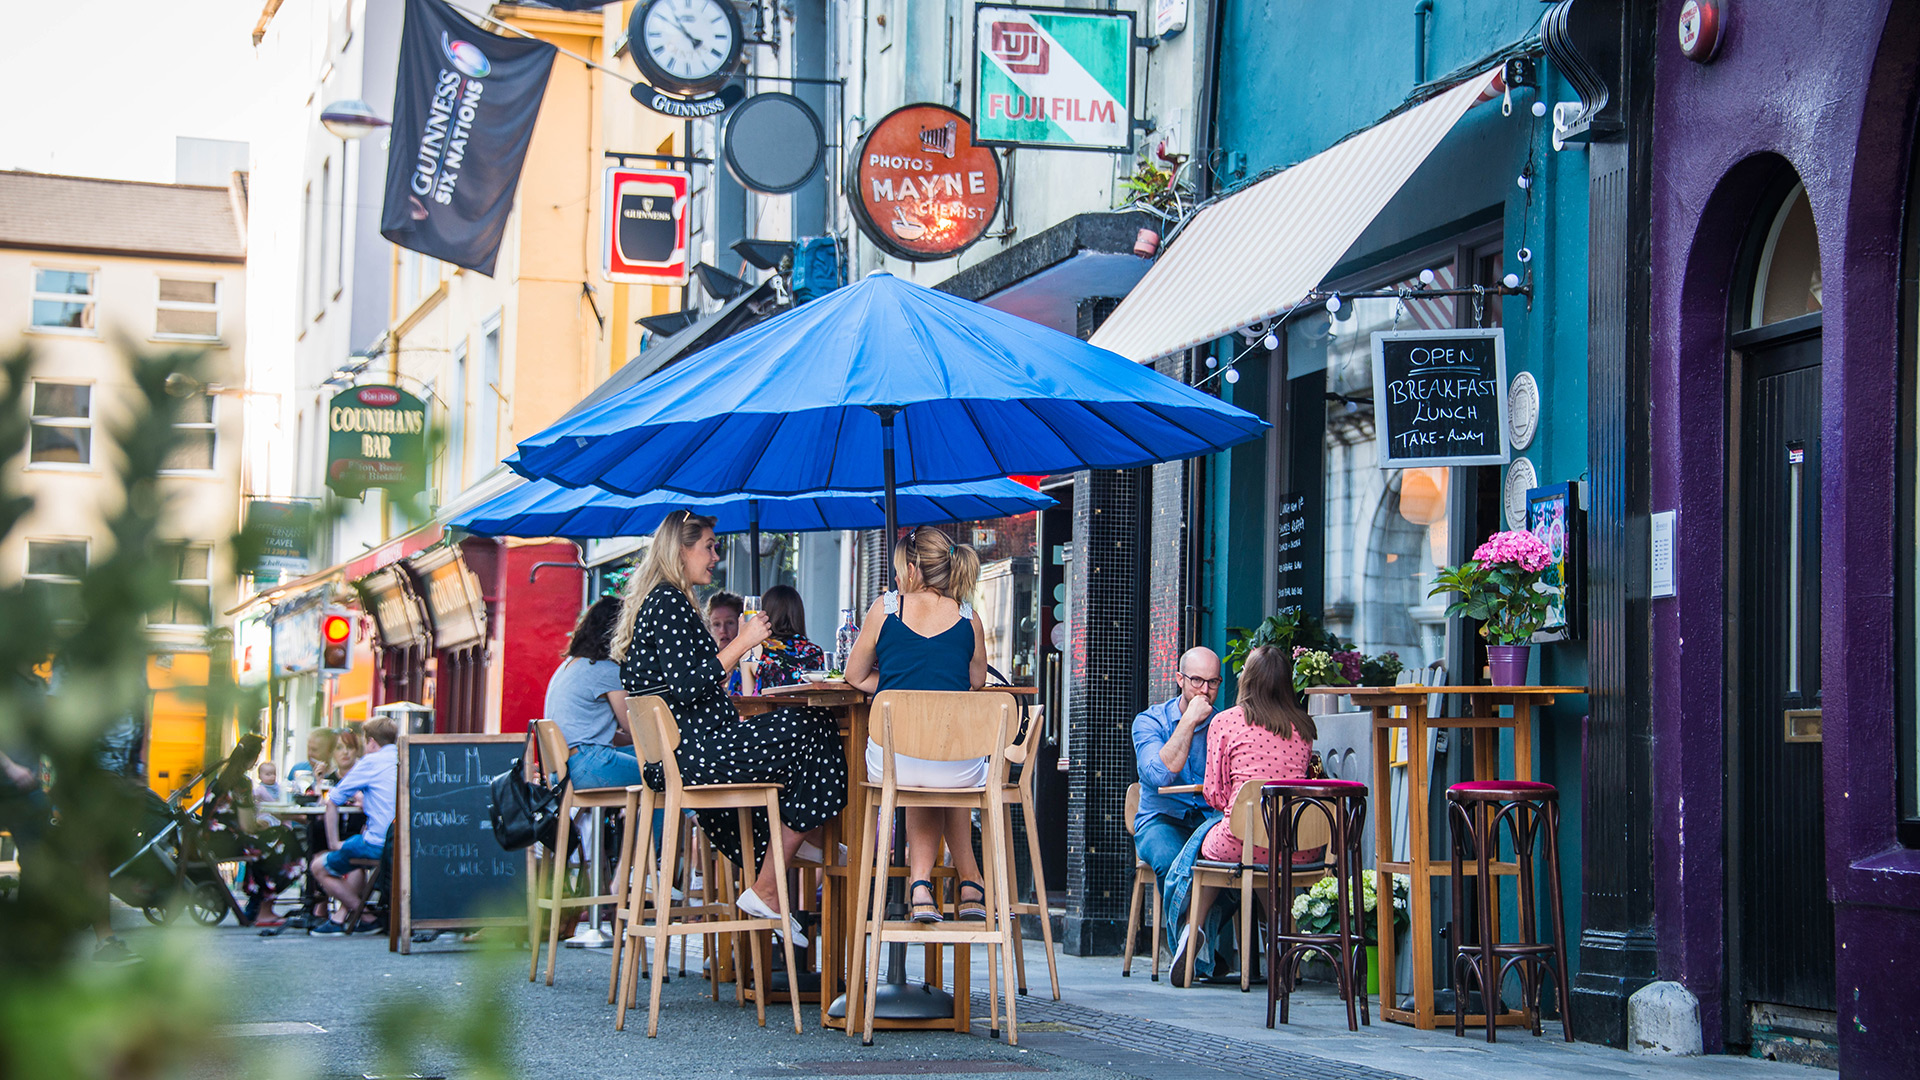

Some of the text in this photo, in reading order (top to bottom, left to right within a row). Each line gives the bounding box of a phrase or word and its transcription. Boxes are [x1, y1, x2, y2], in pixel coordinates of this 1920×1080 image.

[651, 94, 725, 117] GUINNESS
[989, 93, 1116, 124] FUJI FILM
[410, 68, 462, 197] GUINNESS
[435, 79, 485, 206] SIX NATIONS
[869, 153, 933, 172] PHOTOS
[872, 170, 986, 203] MAYNE
[624, 209, 671, 221] GUINNESS
[918, 200, 986, 221] CHEMIST
[1409, 347, 1475, 367] OPEN
[1388, 378, 1497, 405] BREAKFAST
[330, 406, 424, 434] COUNIHANS
[1412, 402, 1478, 425] LUNCH
[361, 433, 391, 459] BAR
[265, 537, 294, 548] TRAVEL
[412, 747, 462, 785] Arthur
